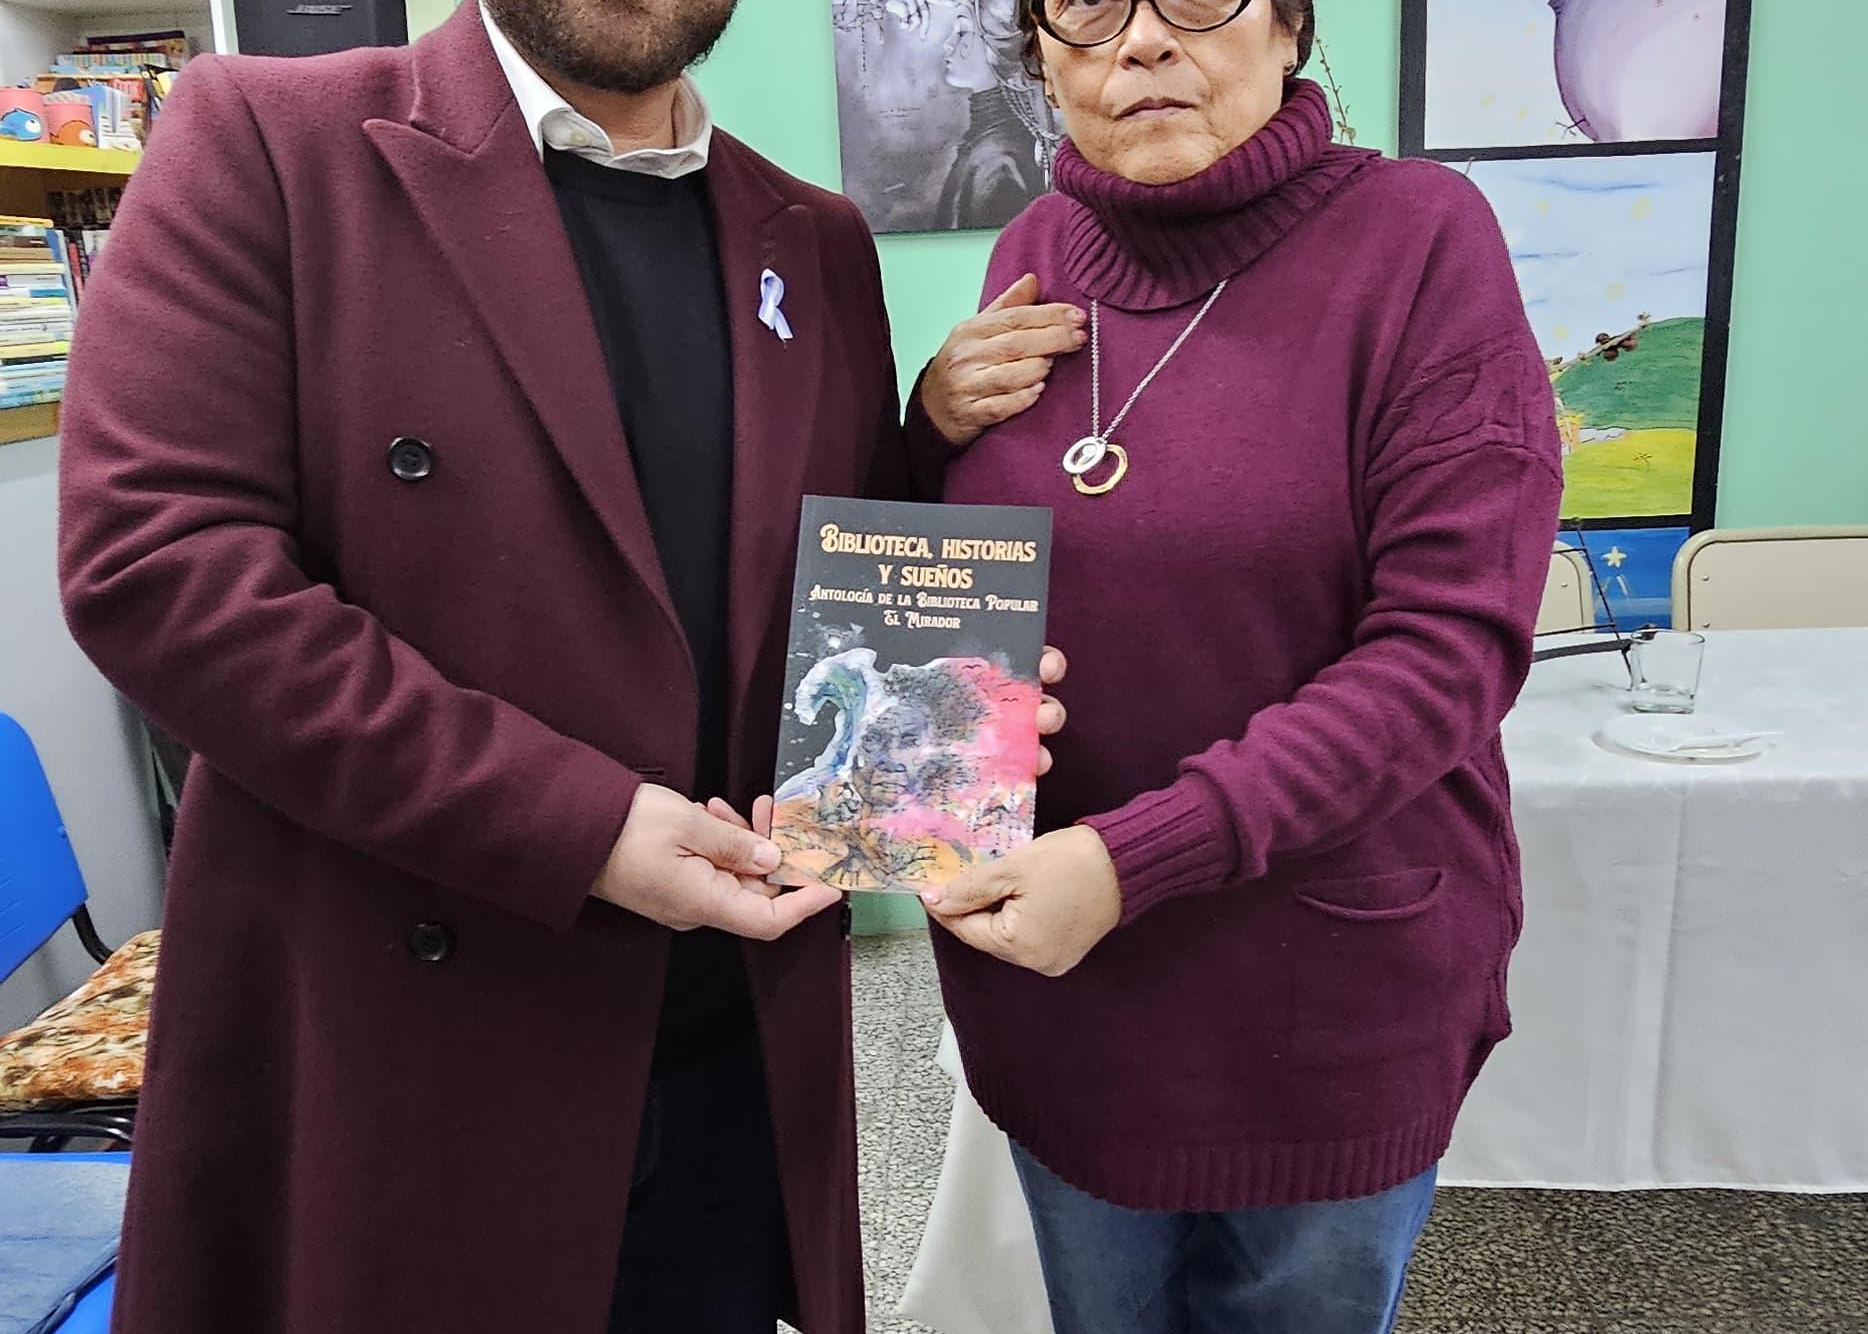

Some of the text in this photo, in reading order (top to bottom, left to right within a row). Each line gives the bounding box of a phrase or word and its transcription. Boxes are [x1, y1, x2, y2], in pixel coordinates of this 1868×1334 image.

[941, 538, 1037, 562] HISTORIAS
[878, 563, 974, 589] Y SUEÑOS
[878, 593, 893, 605] DE
[897, 594, 912, 607] LA
